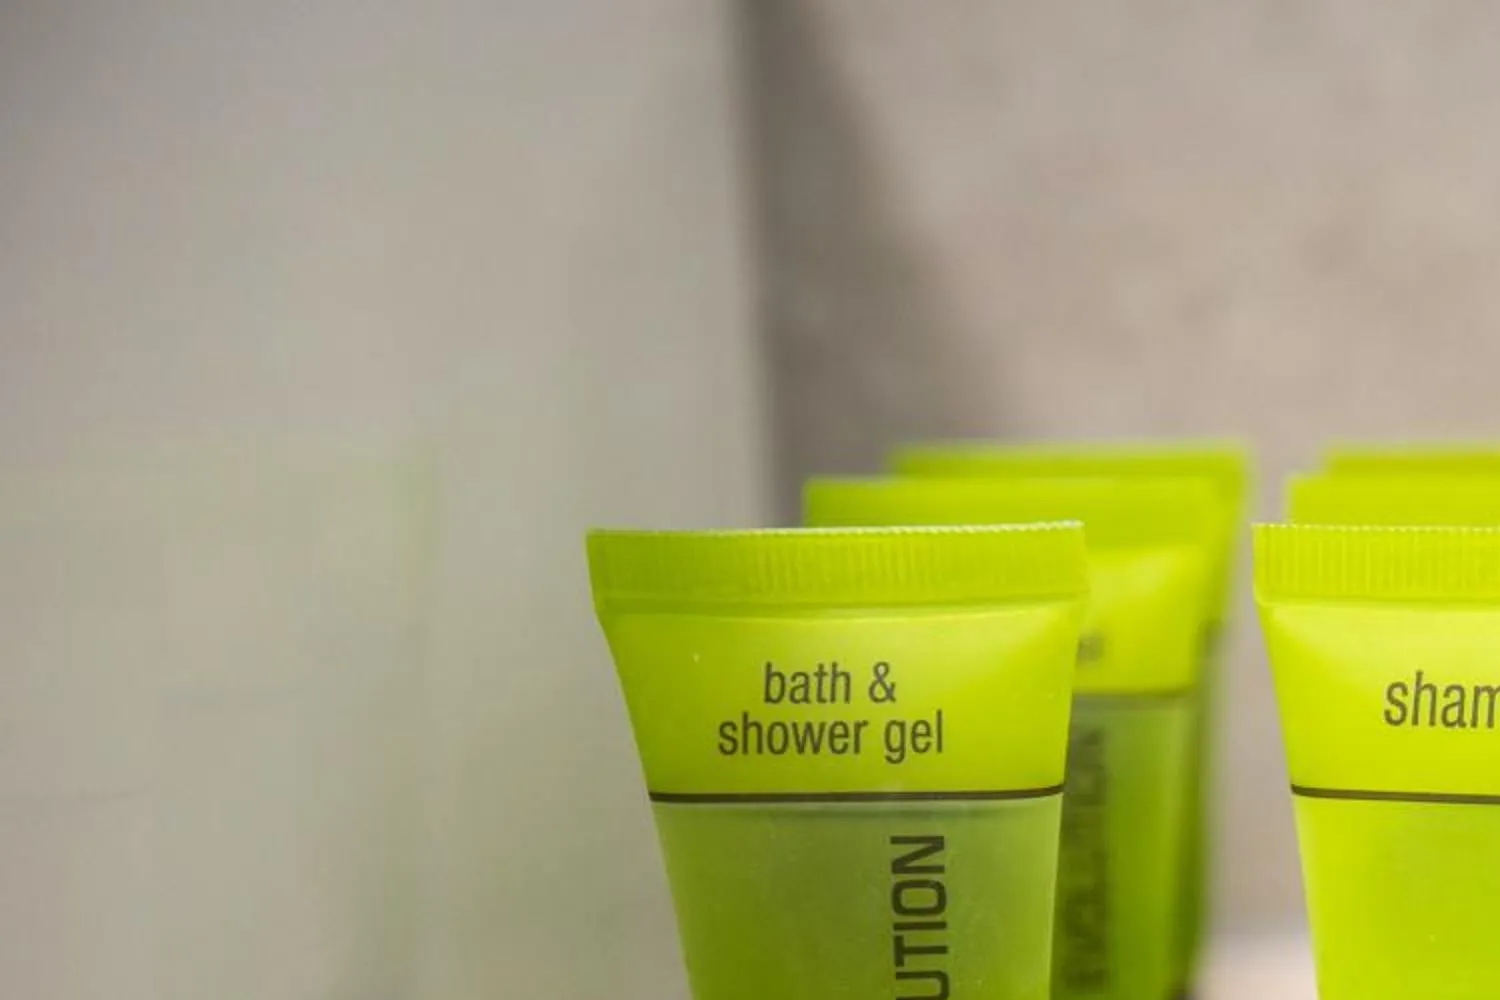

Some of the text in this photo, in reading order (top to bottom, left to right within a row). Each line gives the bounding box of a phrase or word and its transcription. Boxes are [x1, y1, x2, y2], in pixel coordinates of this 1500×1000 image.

[763, 661, 898, 705] bath &
[717, 709, 944, 764] shower gel
